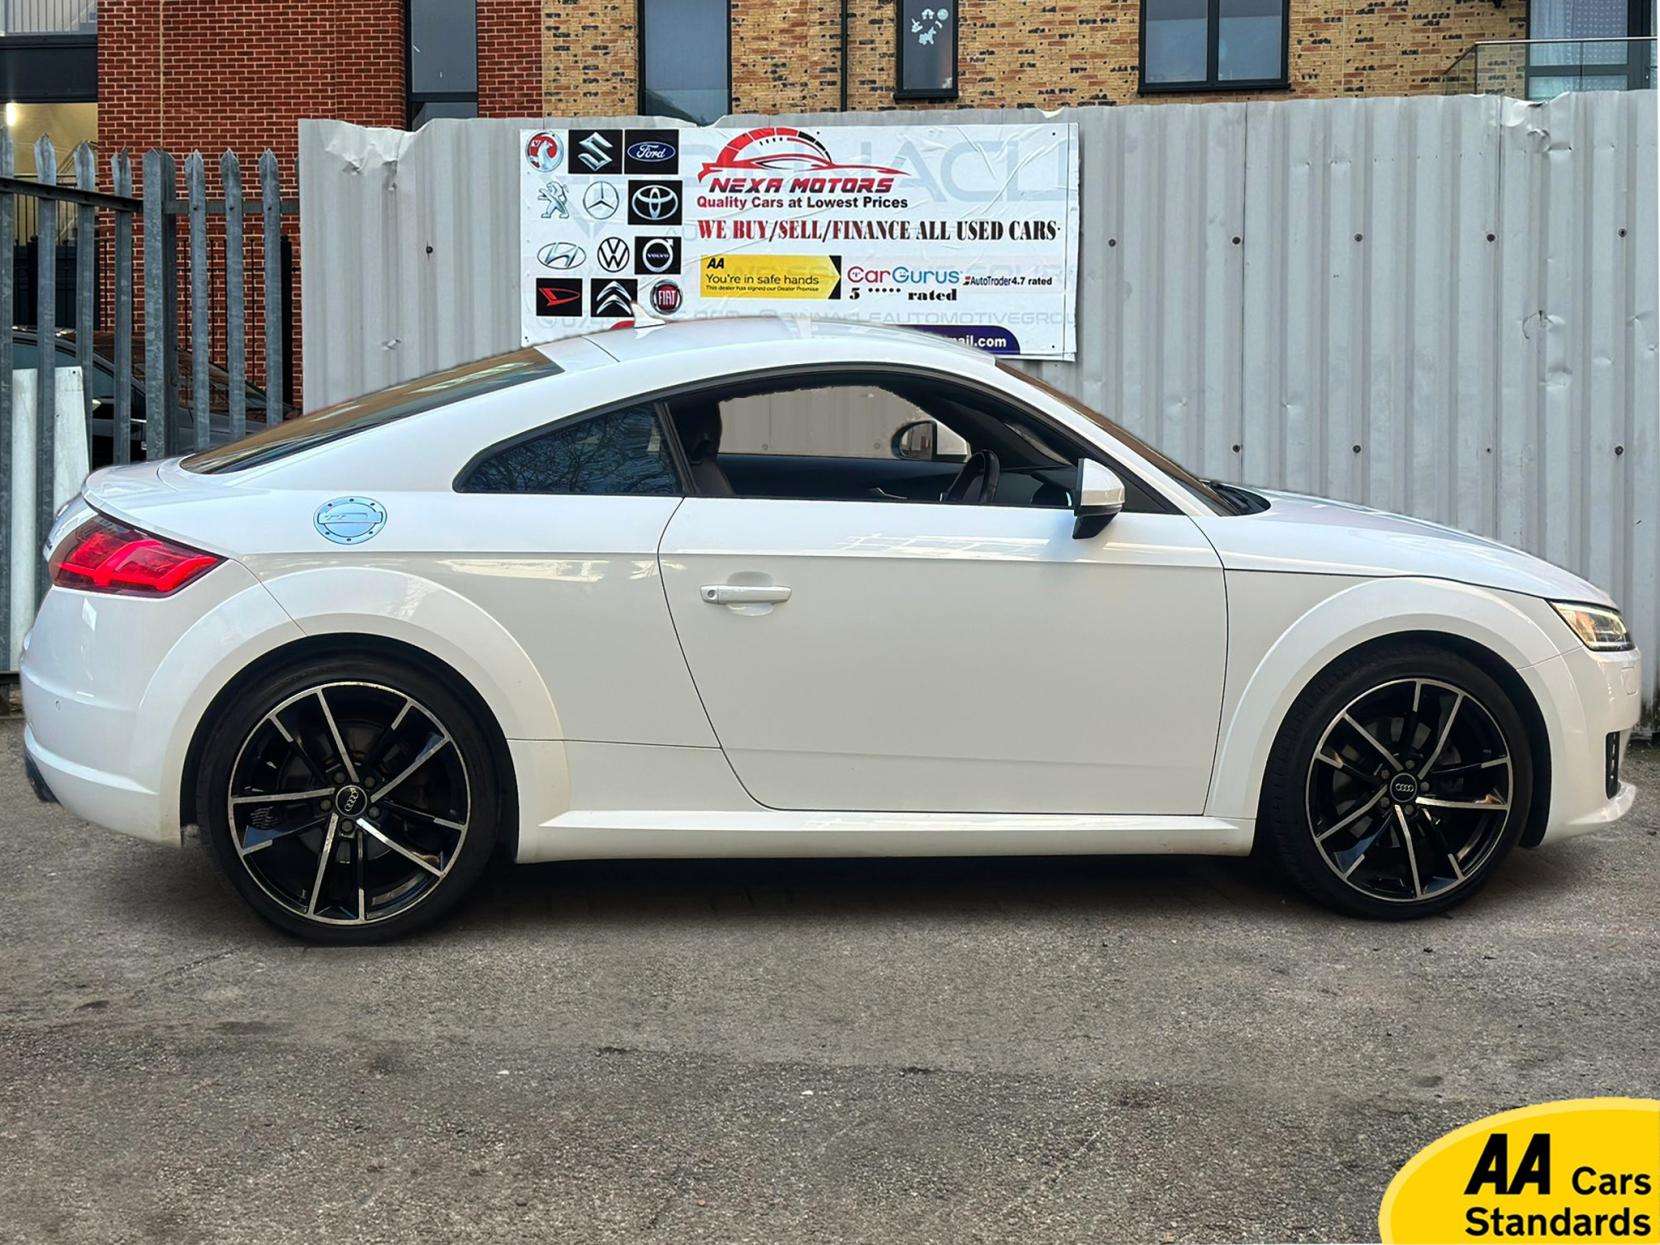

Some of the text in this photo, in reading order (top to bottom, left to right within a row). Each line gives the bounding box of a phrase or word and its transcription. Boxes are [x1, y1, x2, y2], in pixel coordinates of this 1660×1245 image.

[636, 144, 666, 158] Ford
[708, 177, 894, 193] NEXA MOTORS
[697, 196, 908, 210] Quality Cars at Lowest Prices
[697, 220, 726, 239] WE
[916, 220, 951, 240] ALL
[957, 220, 1003, 240] USED
[1009, 220, 1057, 240] CARS
[707, 257, 725, 269] AA
[706, 273, 819, 285] You're in safe hands
[847, 266, 960, 284] CarGurus
[1028, 276, 1053, 285] rated
[658, 290, 677, 305] FIAT
[849, 287, 957, 301] 5 rated
